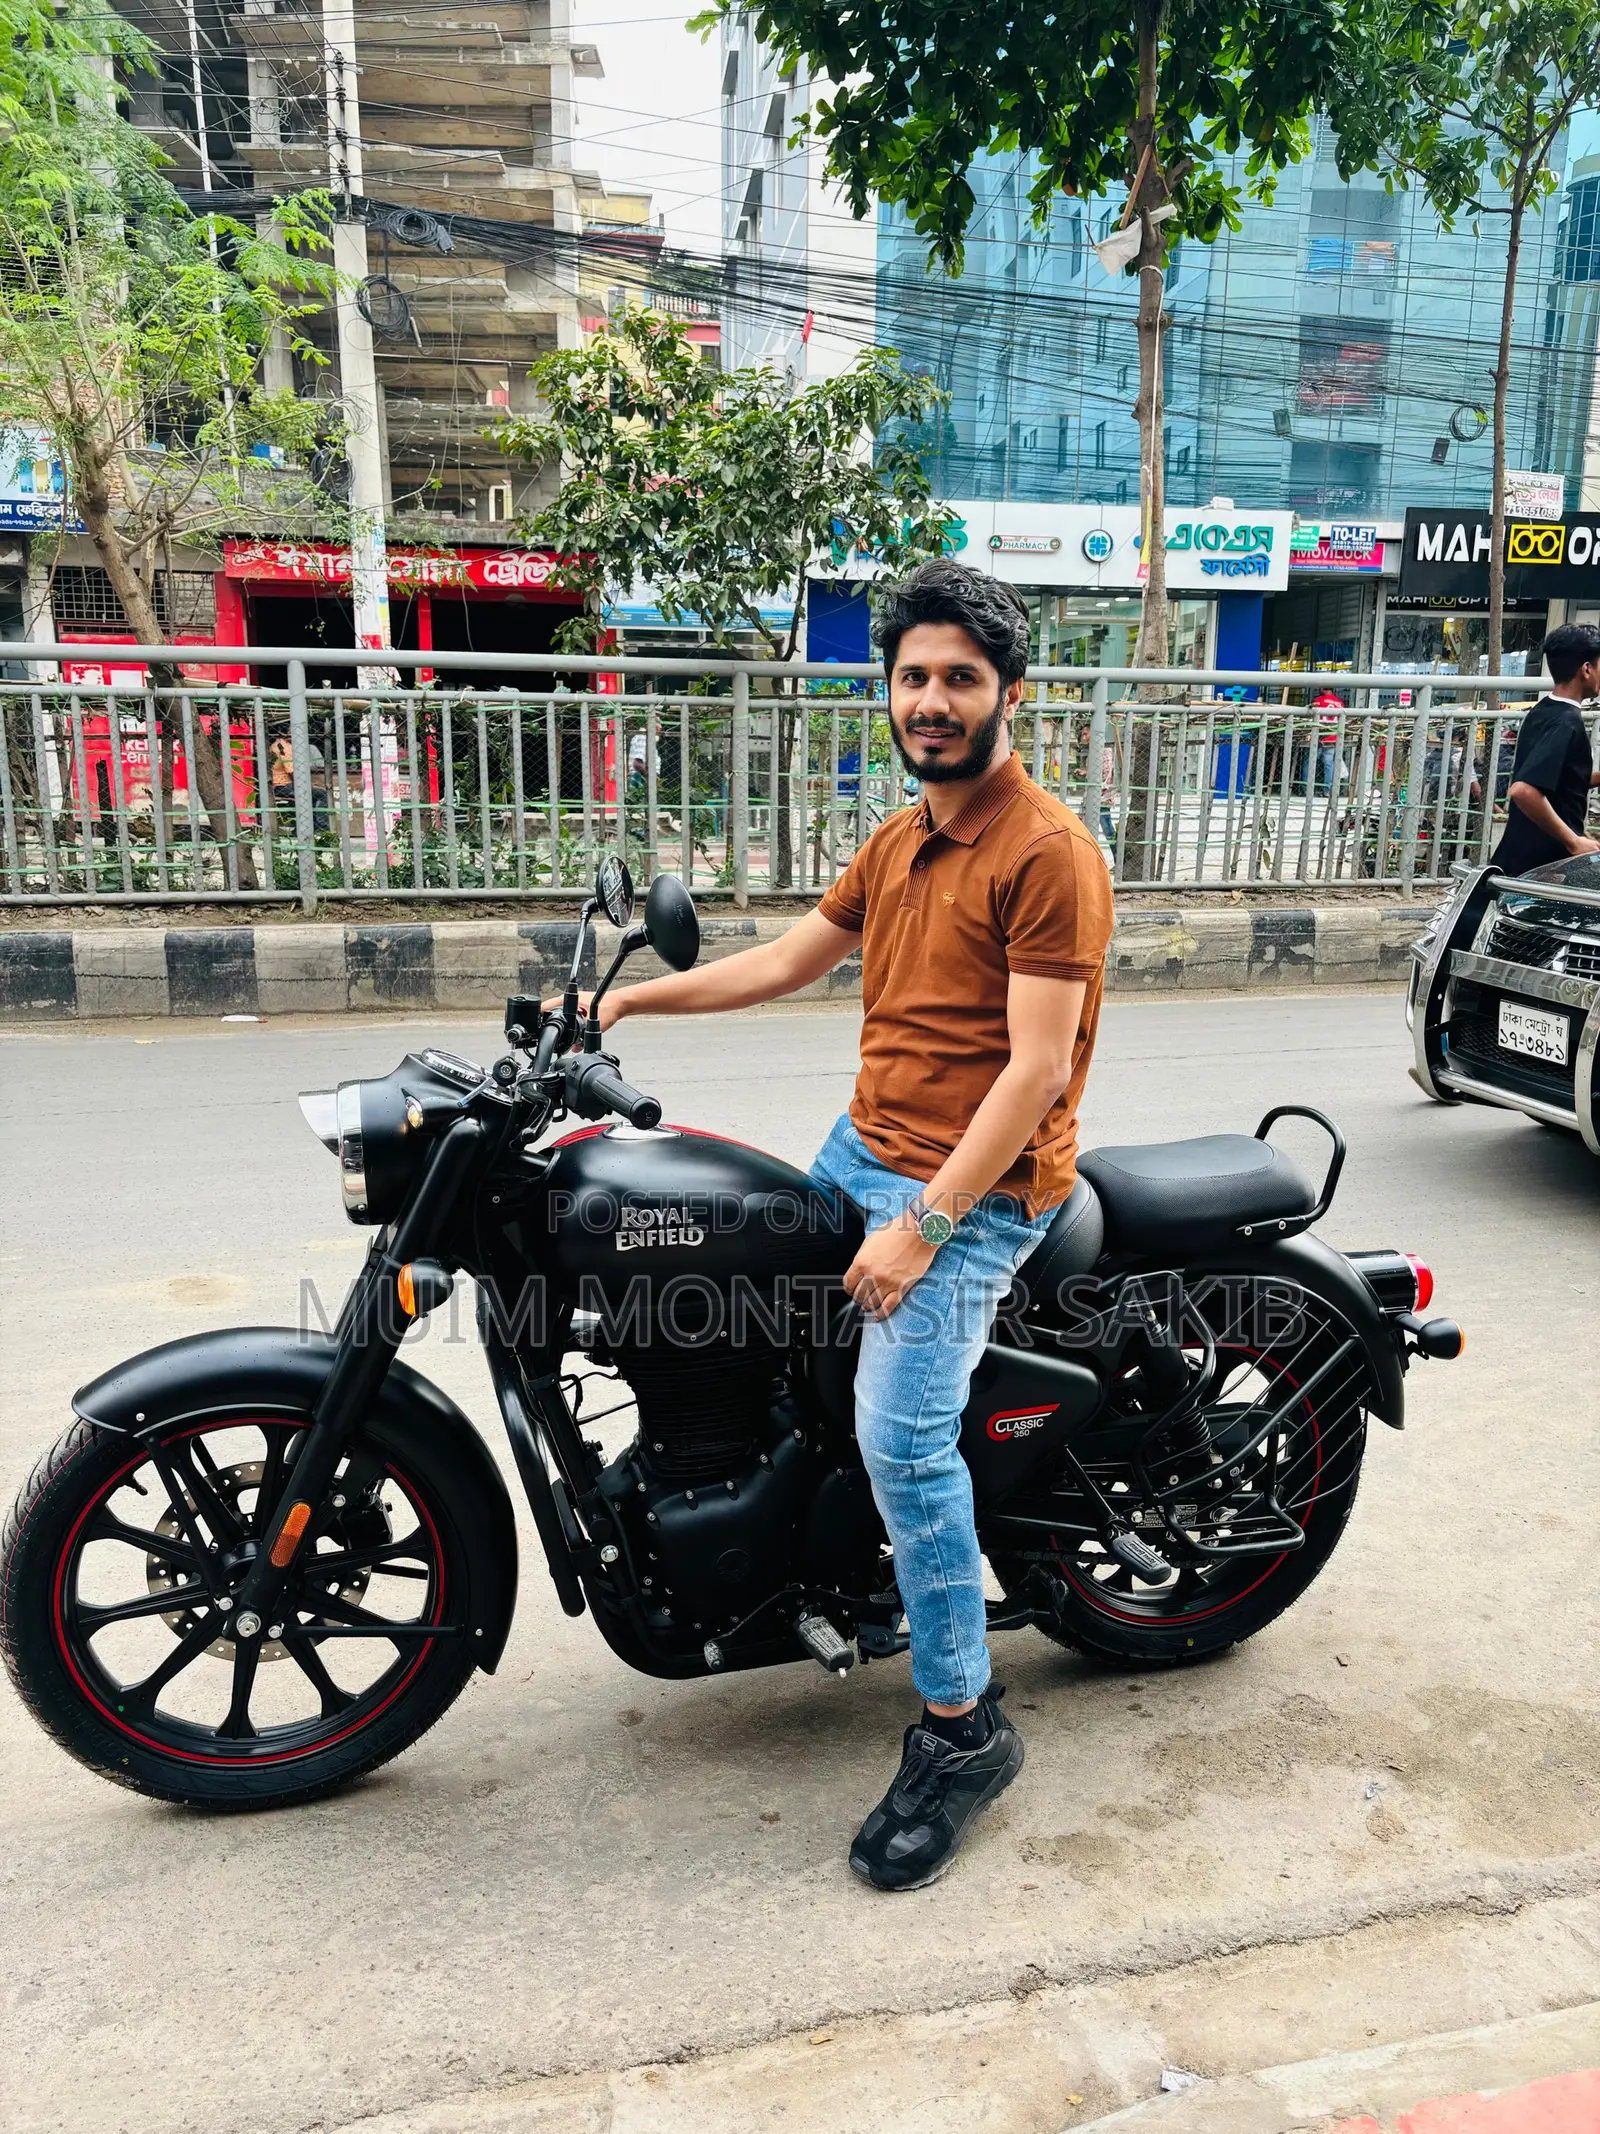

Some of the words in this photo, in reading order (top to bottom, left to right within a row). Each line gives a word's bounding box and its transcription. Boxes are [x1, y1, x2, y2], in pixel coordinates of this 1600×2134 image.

[1333, 527, 1374, 542] TO-LET
[1003, 541, 1048, 550] PHARMACY
[1417, 522, 1506, 563] MAH
[1458, 597, 1517, 605] OPTS
[1502, 1011, 1522, 1026] ঢাকা
[1499, 1028, 1565, 1060] ১৭-৩৪৮১
[621, 1206, 694, 1229] ROYAL
[615, 1227, 705, 1251] ENFIELD
[1013, 1429, 1030, 1438] 350
